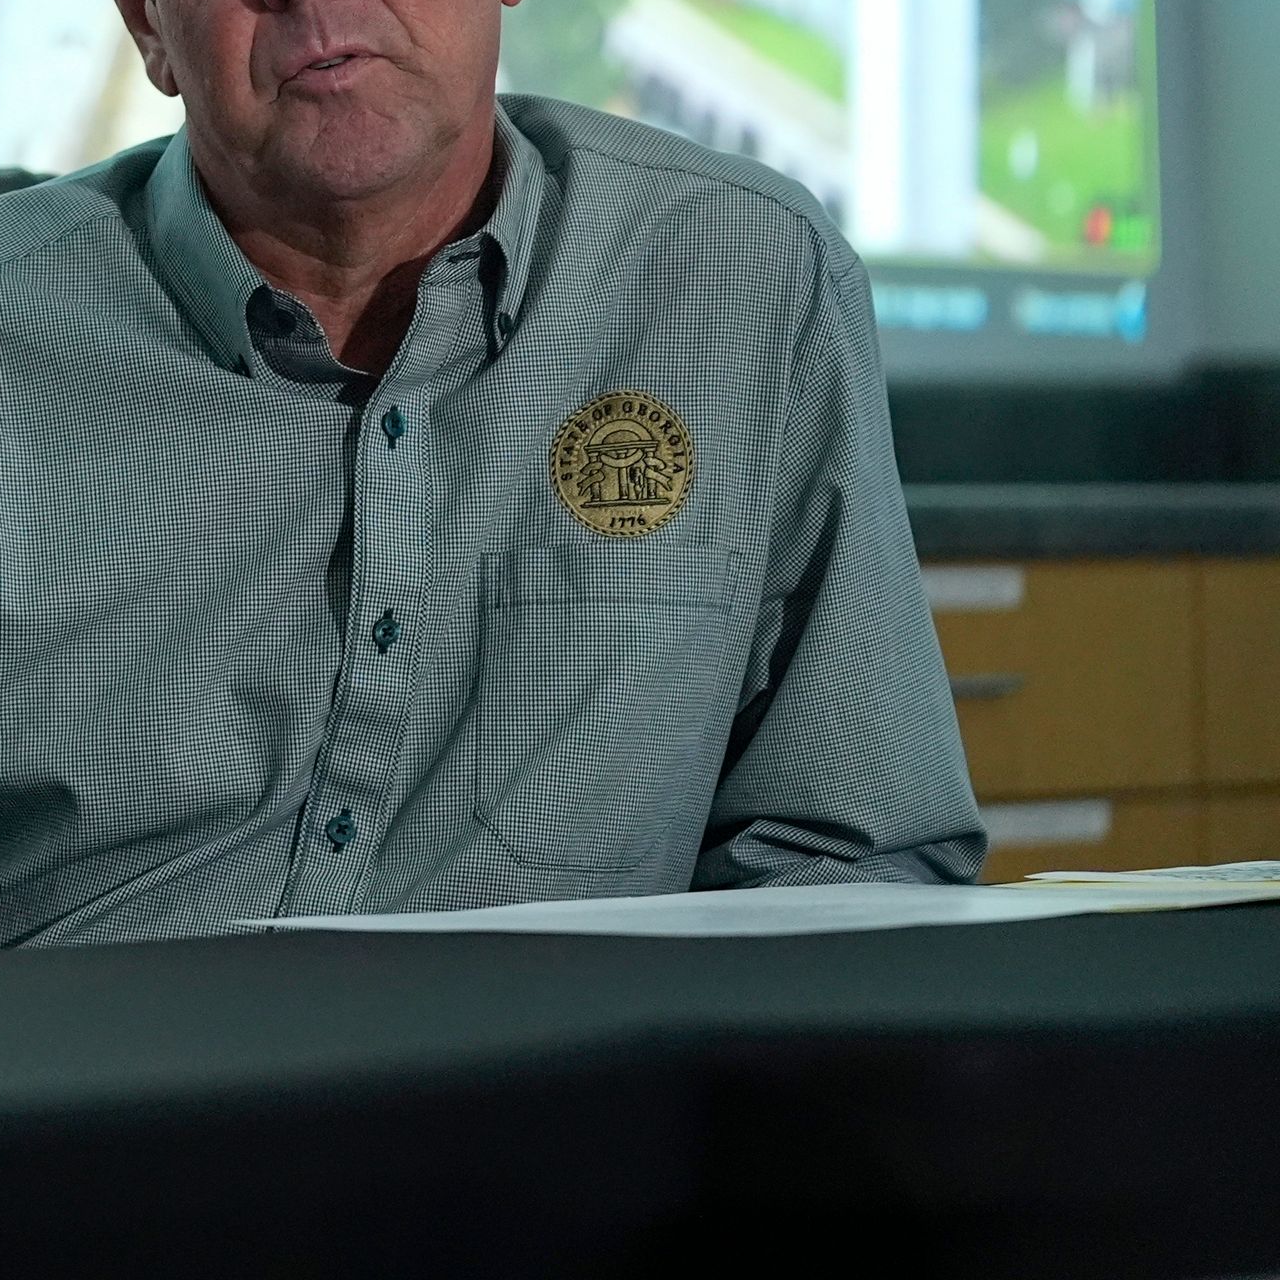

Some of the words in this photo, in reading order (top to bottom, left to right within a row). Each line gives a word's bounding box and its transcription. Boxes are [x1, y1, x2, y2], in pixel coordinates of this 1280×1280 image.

[560, 421, 589, 481] STATE
[591, 404, 613, 421] OF
[622, 400, 685, 474] GEORGIA
[608, 514, 648, 530] 1776
